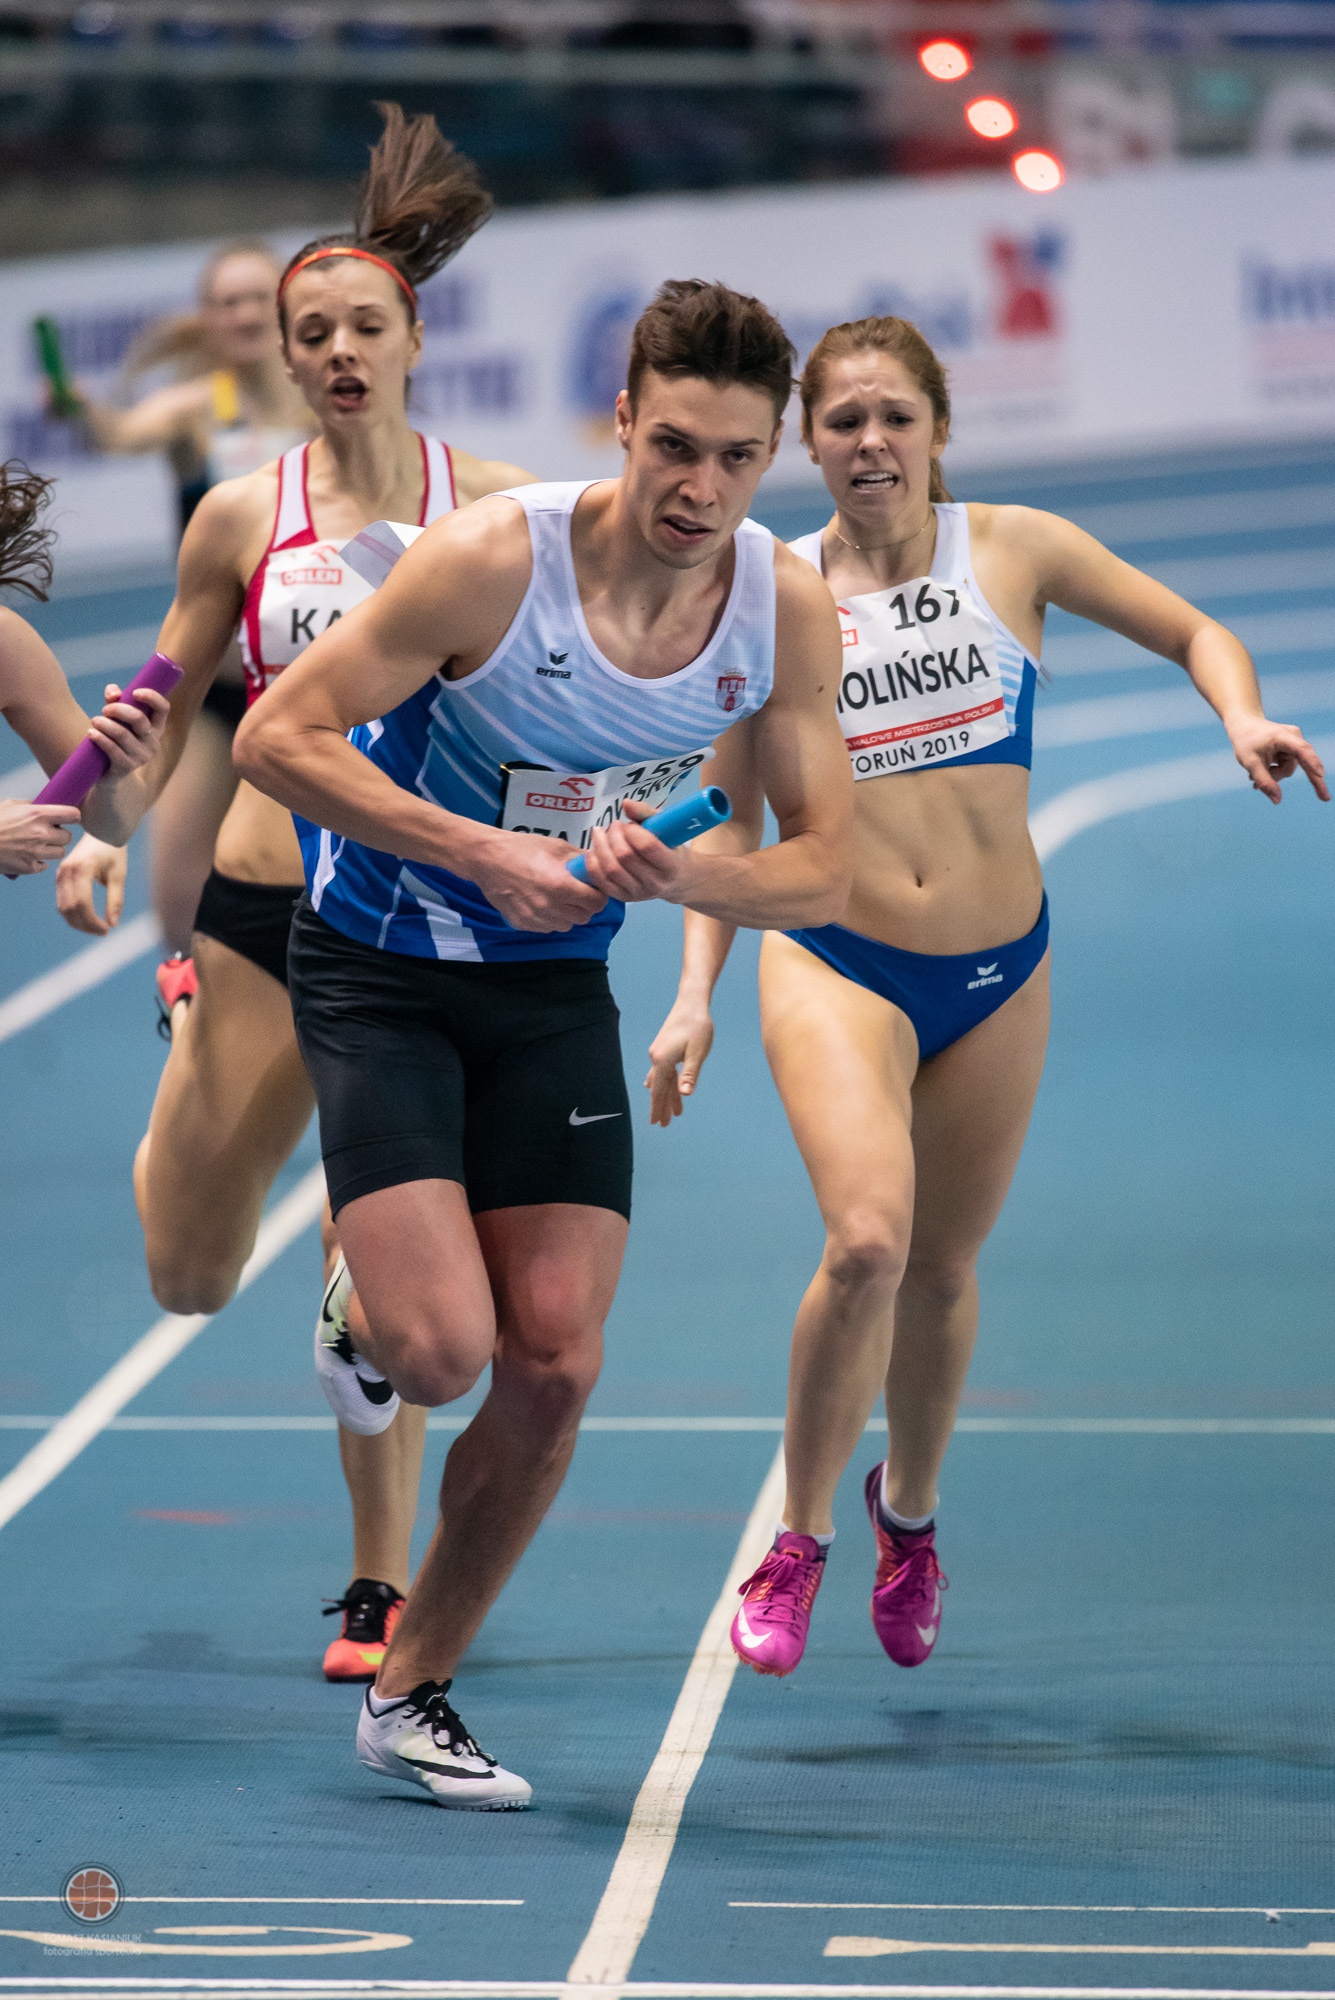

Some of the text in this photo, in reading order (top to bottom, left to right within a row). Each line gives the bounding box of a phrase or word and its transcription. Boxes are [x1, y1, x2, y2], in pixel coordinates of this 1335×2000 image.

[283, 571, 340, 584] ORLEN
[536, 666, 571, 680] erima
[854, 731, 893, 749] HALOWE
[893, 714, 964, 739] MISTRZOSTWA
[964, 703, 995, 722] POLSKI
[851, 730, 970, 774] ORUŃ 2019
[620, 754, 705, 789] 159
[529, 794, 593, 811] ORLEN
[967, 973, 1004, 990] erima
